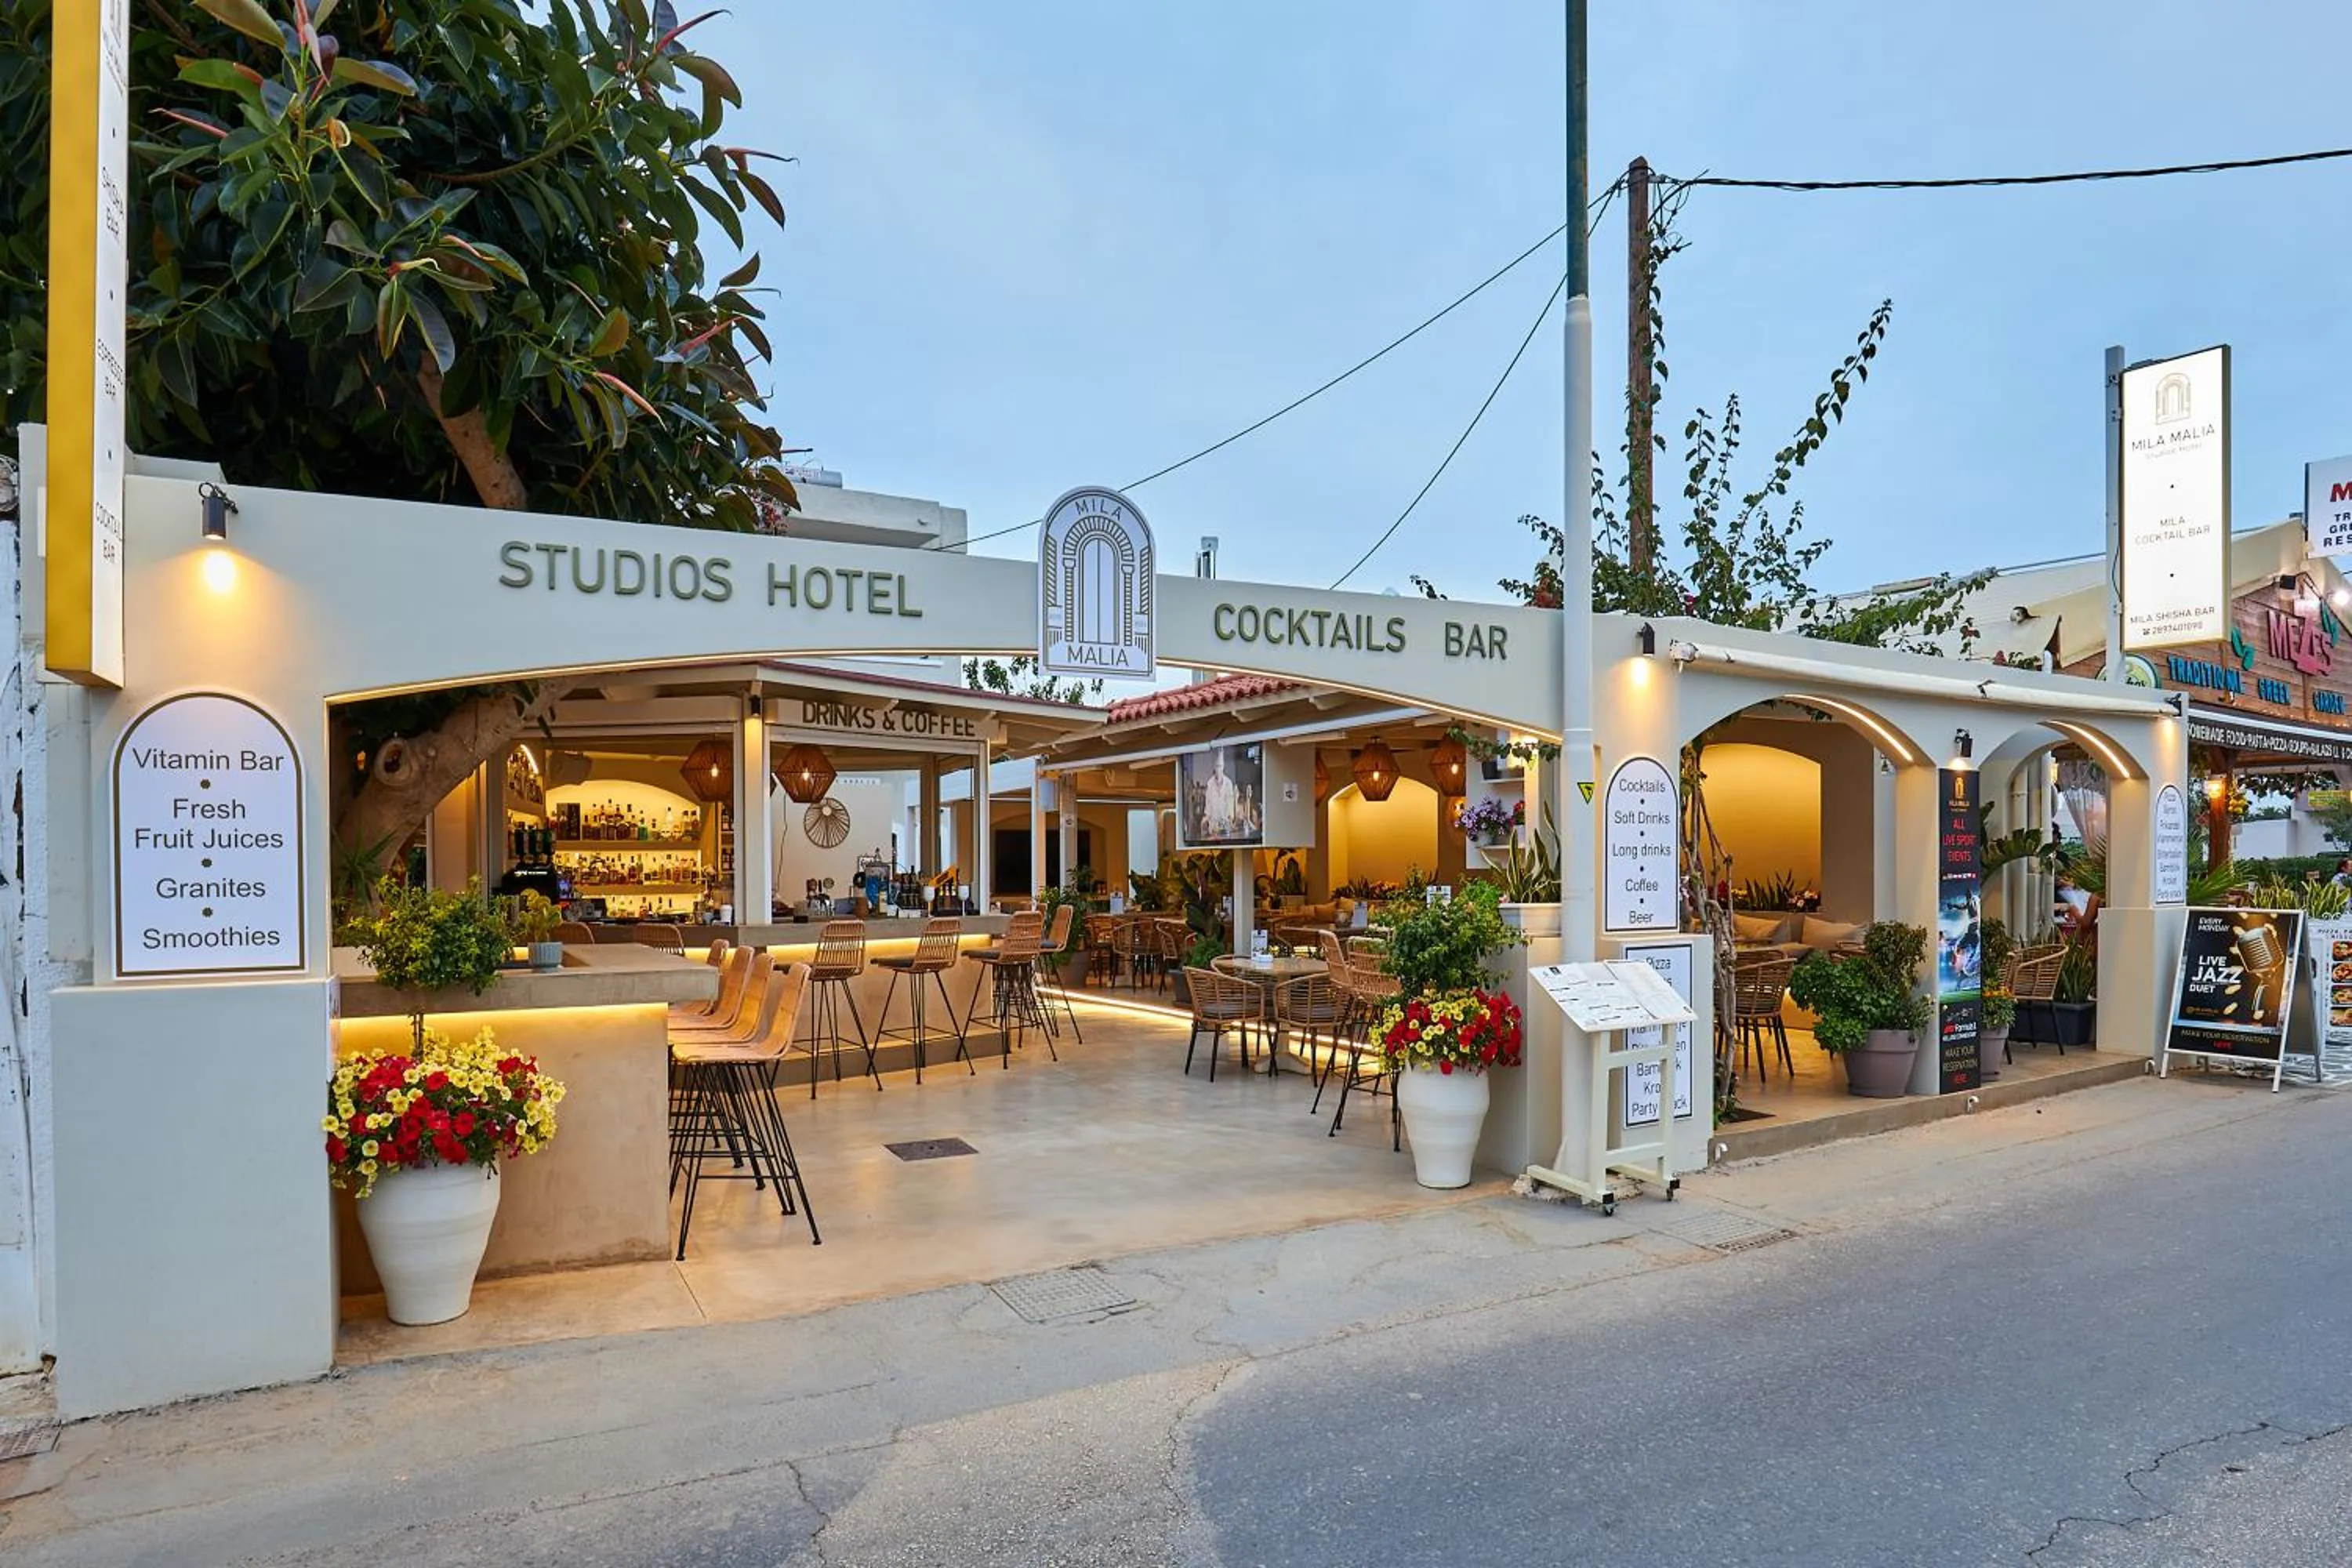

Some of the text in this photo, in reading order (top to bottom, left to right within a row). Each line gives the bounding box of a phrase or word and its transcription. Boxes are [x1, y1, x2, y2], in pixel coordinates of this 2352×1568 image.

[102, 165, 125, 220] SHISHA
[107, 206, 120, 245] BAR
[97, 338, 124, 386] ESPRESSO
[105, 376, 116, 403] BAR
[2132, 423, 2215, 452] MILA MALIA
[1075, 498, 1122, 521] MILA
[96, 501, 123, 542] COCKTAIL
[2160, 516, 2186, 527] MILA
[2135, 524, 2210, 546] COCKTAIL BAR
[499, 541, 923, 617] STUDIOS HOTEL
[2194, 605, 2216, 617] BAR
[1214, 603, 1508, 660] COCKTAILS BAR
[1067, 645, 1130, 666] MALIA
[803, 702, 976, 737] DRINKS & COFFEE
[132, 748, 285, 771] Vitamin Bar
[1619, 779, 1666, 793] Cocktails
[172, 798, 246, 818] Fresh
[1614, 810, 1671, 825] Soft Drinks
[135, 828, 284, 849] Fruit Juices
[1613, 843, 1671, 860] Long drinks
[156, 877, 267, 899] Granites
[1625, 879, 1659, 892] Coffee
[1629, 910, 1654, 924] Beer
[143, 927, 281, 949] Smoothies
[2198, 956, 2227, 966] LIVE
[2192, 966, 2244, 983] JAZZ
[2188, 984, 2216, 993] DUET
[1632, 1102, 1657, 1116] Party
